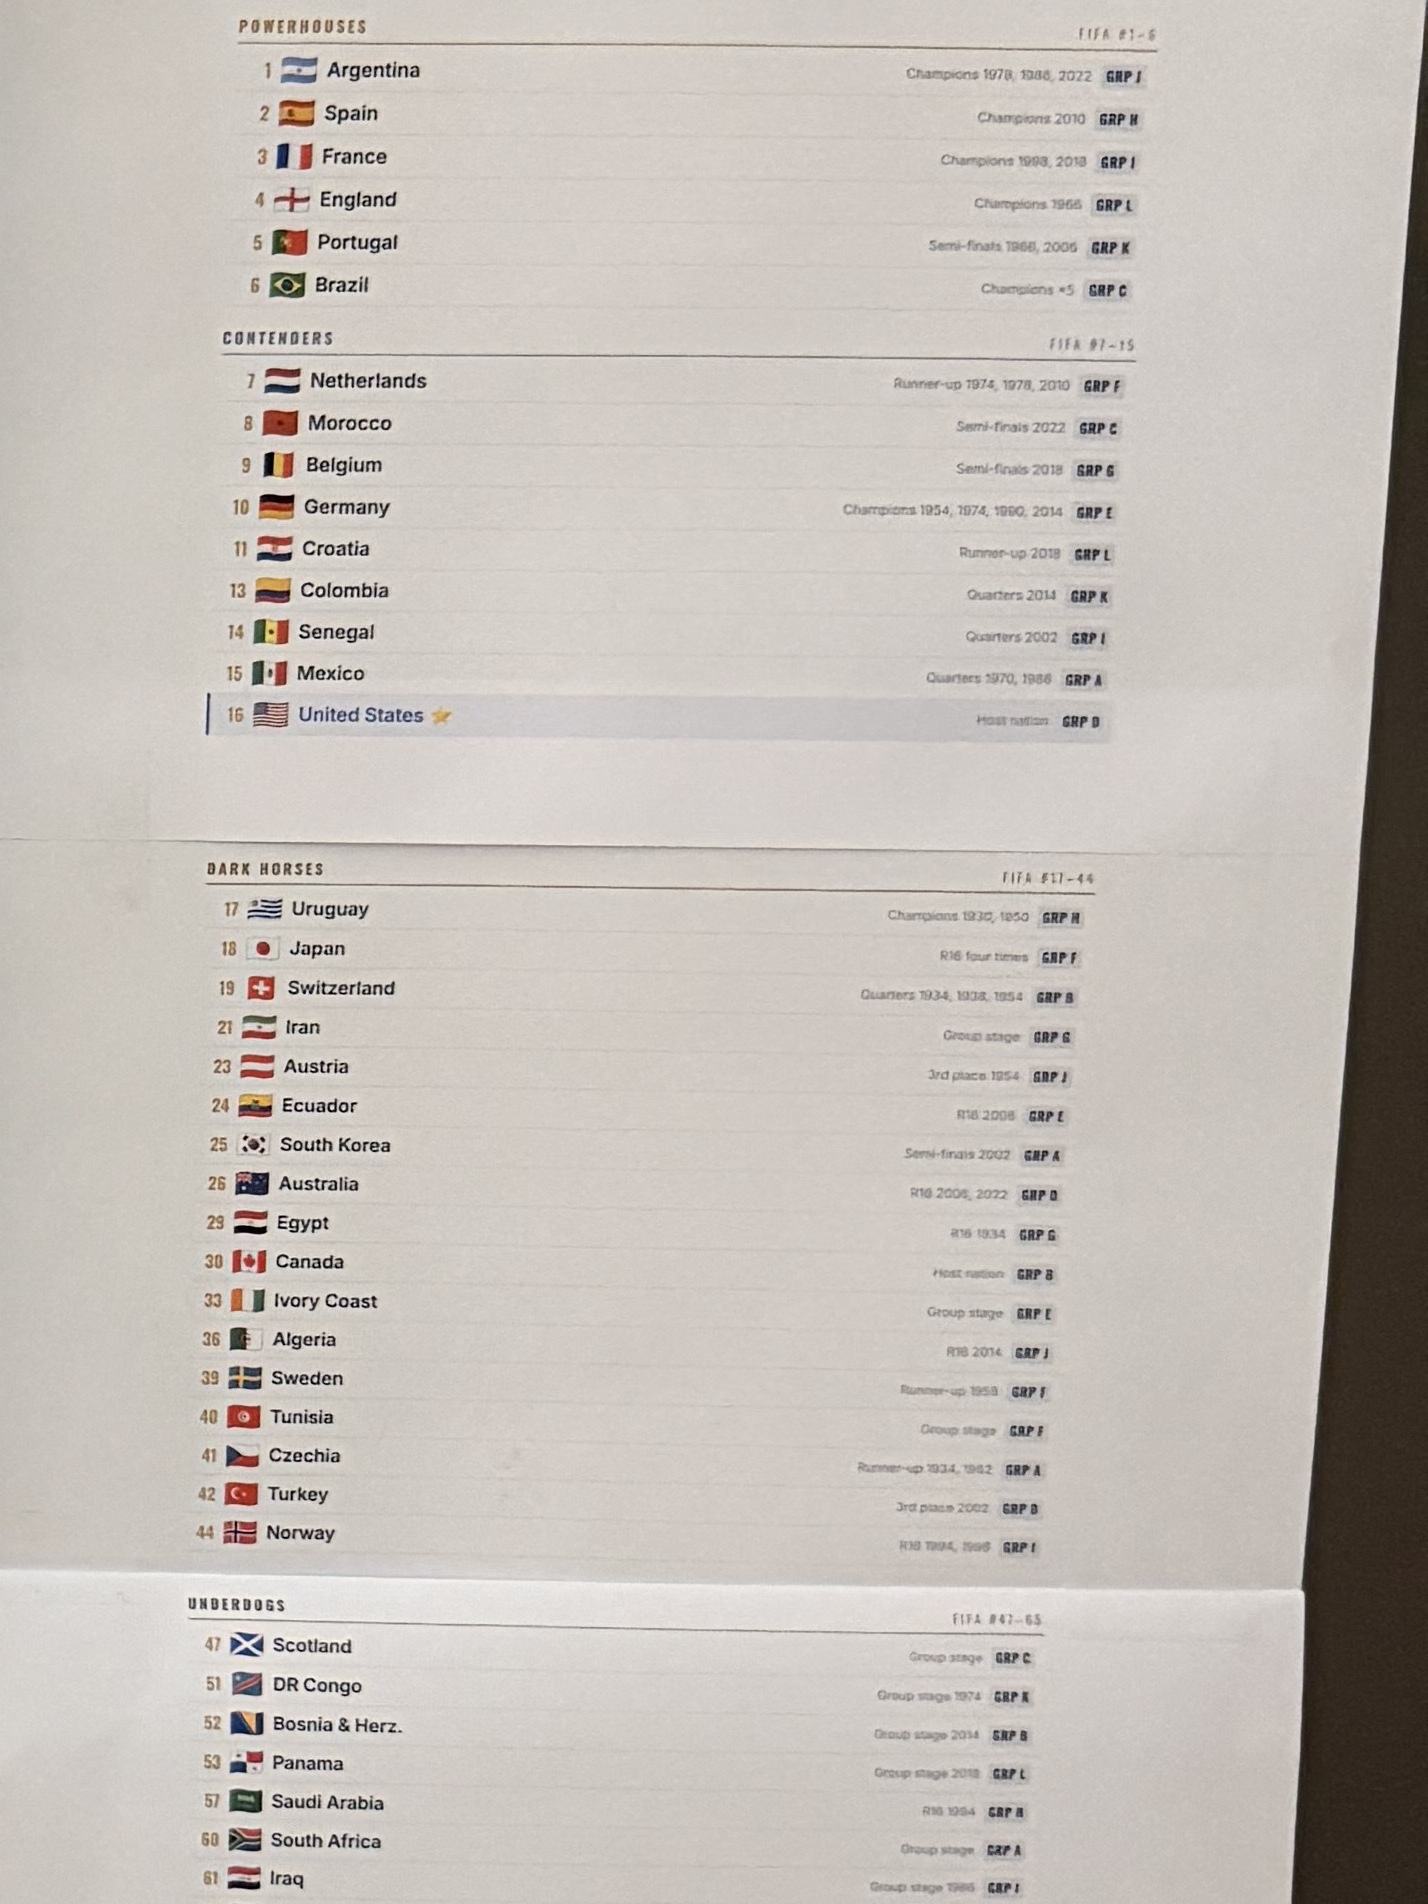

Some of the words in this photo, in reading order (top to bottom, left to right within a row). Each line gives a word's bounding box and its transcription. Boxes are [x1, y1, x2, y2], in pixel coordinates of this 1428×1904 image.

[327, 62, 420, 81] Argentina
[325, 105, 377, 124] Spain
[318, 234, 397, 253] Portugal
[299, 706, 359, 722] United
[365, 707, 423, 722] States
[288, 980, 395, 995] Switzerland
[281, 1137, 332, 1151] South
[339, 1138, 390, 1152] Korea
[274, 1677, 298, 1691] DR
[304, 1678, 362, 1696] Congo
